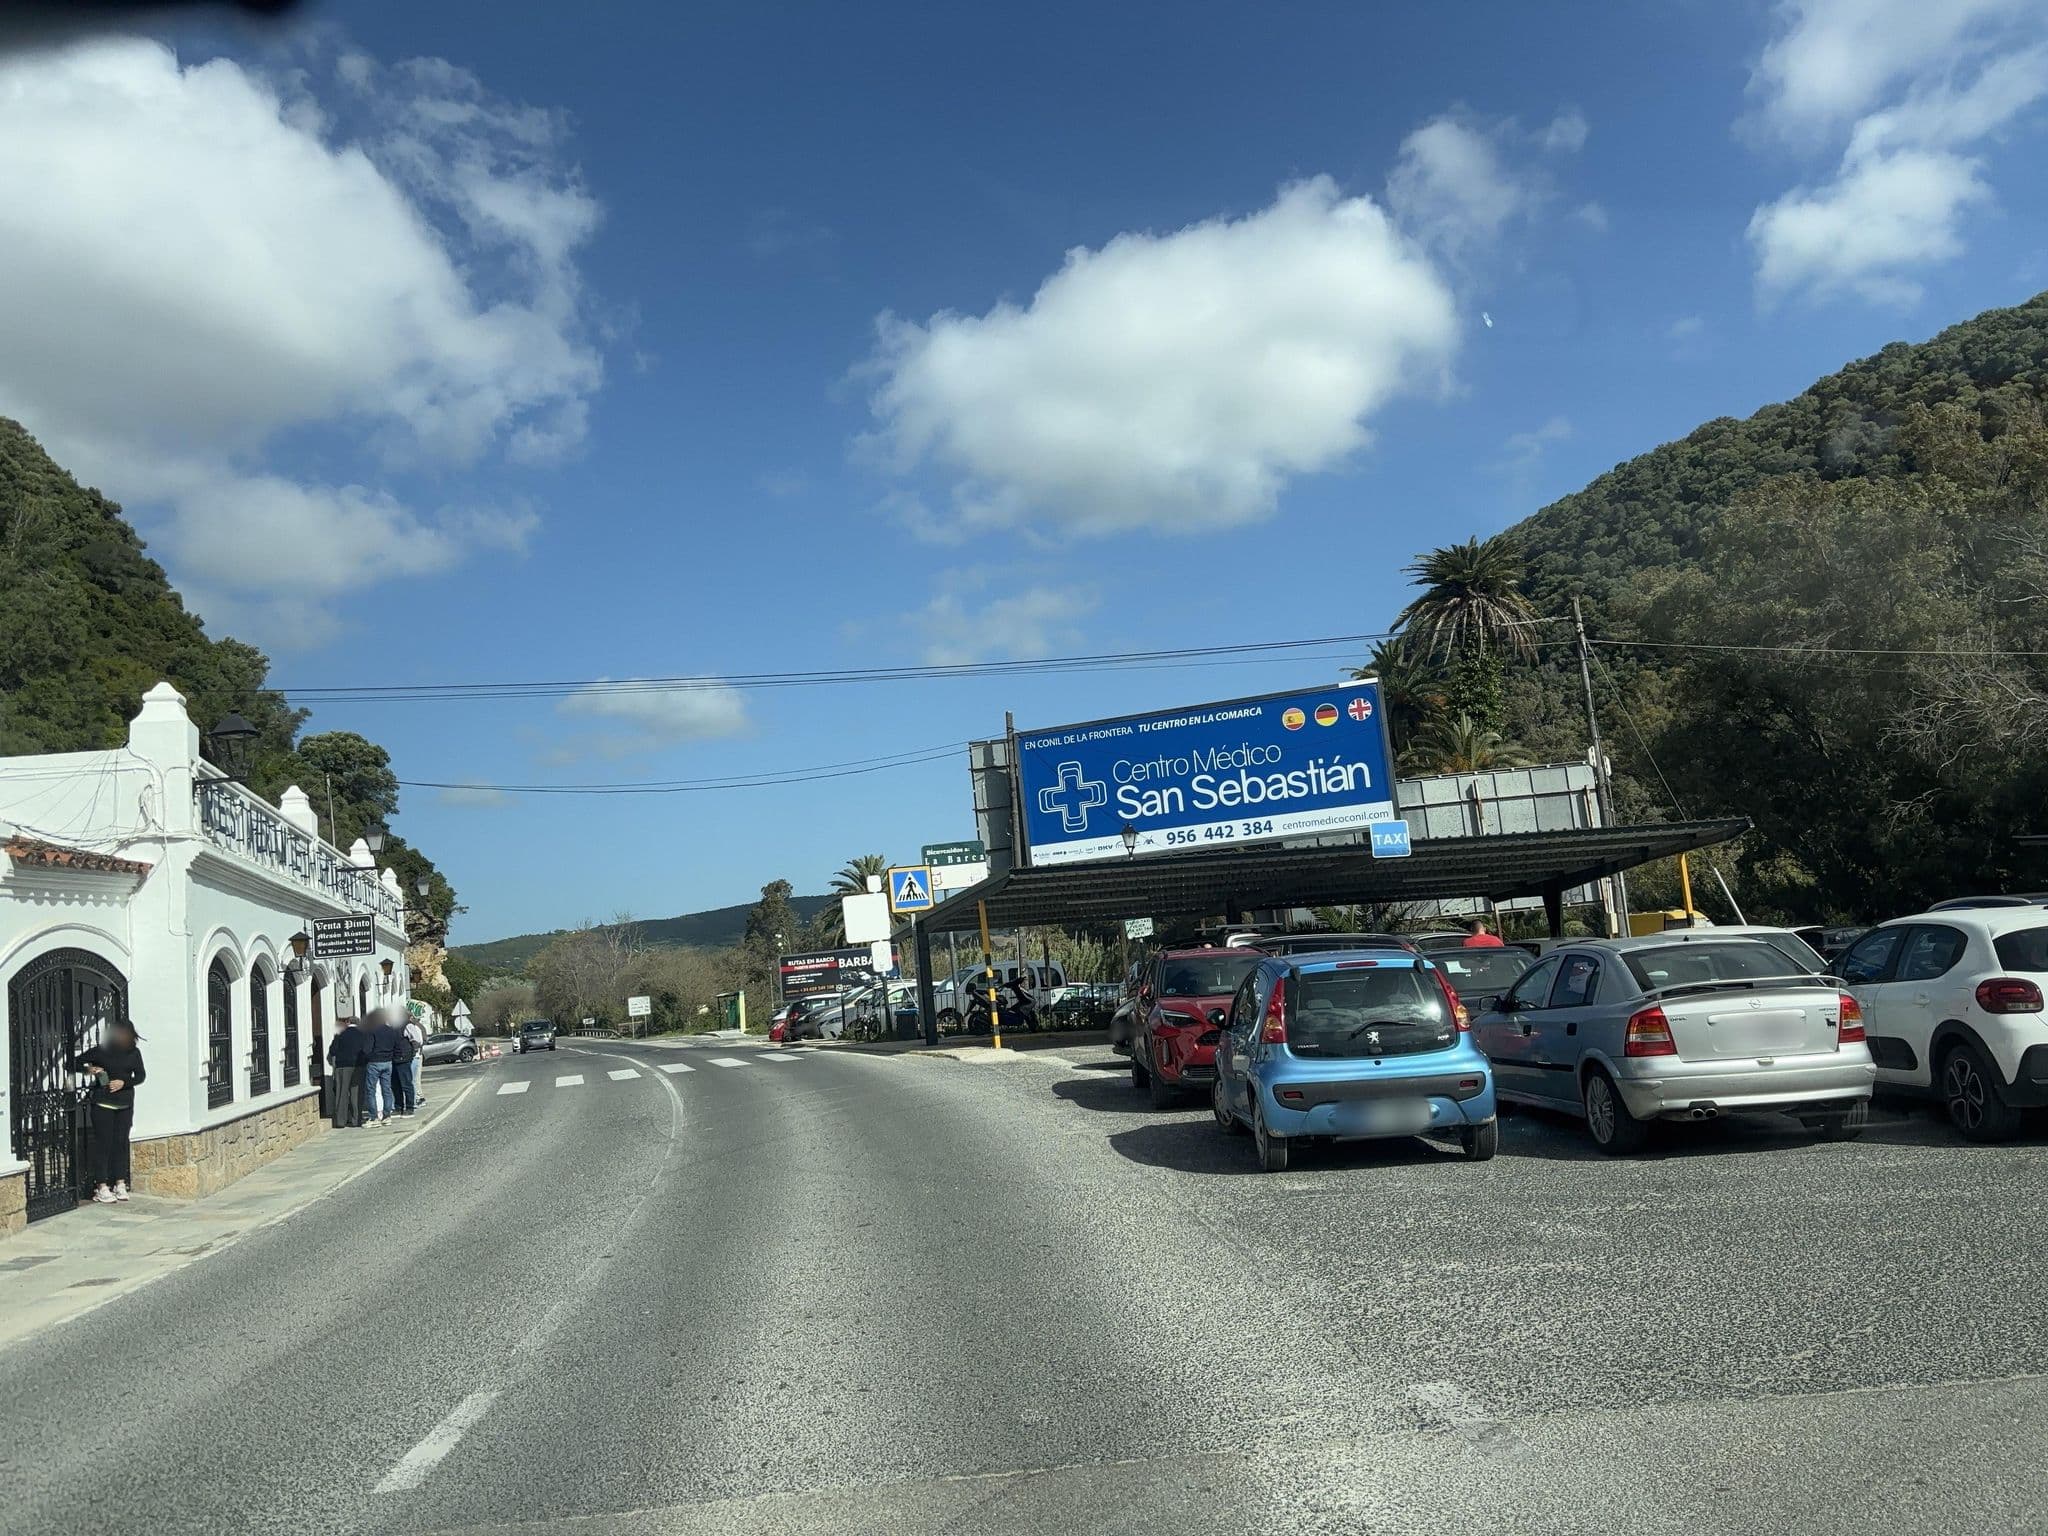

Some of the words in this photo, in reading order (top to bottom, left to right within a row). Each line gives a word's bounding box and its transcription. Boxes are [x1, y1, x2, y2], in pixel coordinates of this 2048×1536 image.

[1024, 741, 1036, 750] EN
[1037, 737, 1063, 749] CONIL
[1064, 735, 1076, 745] DE
[1077, 733, 1088, 743] LA
[1089, 726, 1134, 741] FRONTERA
[1138, 723, 1151, 733] TU
[1151, 718, 1188, 732] CENTRO
[1189, 716, 1201, 726] EN
[1202, 713, 1214, 723] LA
[1215, 707, 1263, 722] COMARCA
[1113, 754, 1189, 784] Centro
[1193, 744, 1282, 773] Médico
[1117, 785, 1185, 819] San
[1192, 755, 1372, 809] Sebastián
[1167, 829, 1197, 845] 956
[1204, 825, 1234, 840] 442
[1243, 820, 1273, 835] 384
[1282, 810, 1389, 830] centromedicoconil.com
[1375, 833, 1408, 846] TAXI
[925, 857, 938, 865] La
[948, 854, 985, 863] Barca
[314, 922, 341, 931] Venta
[344, 920, 370, 930] Pinto
